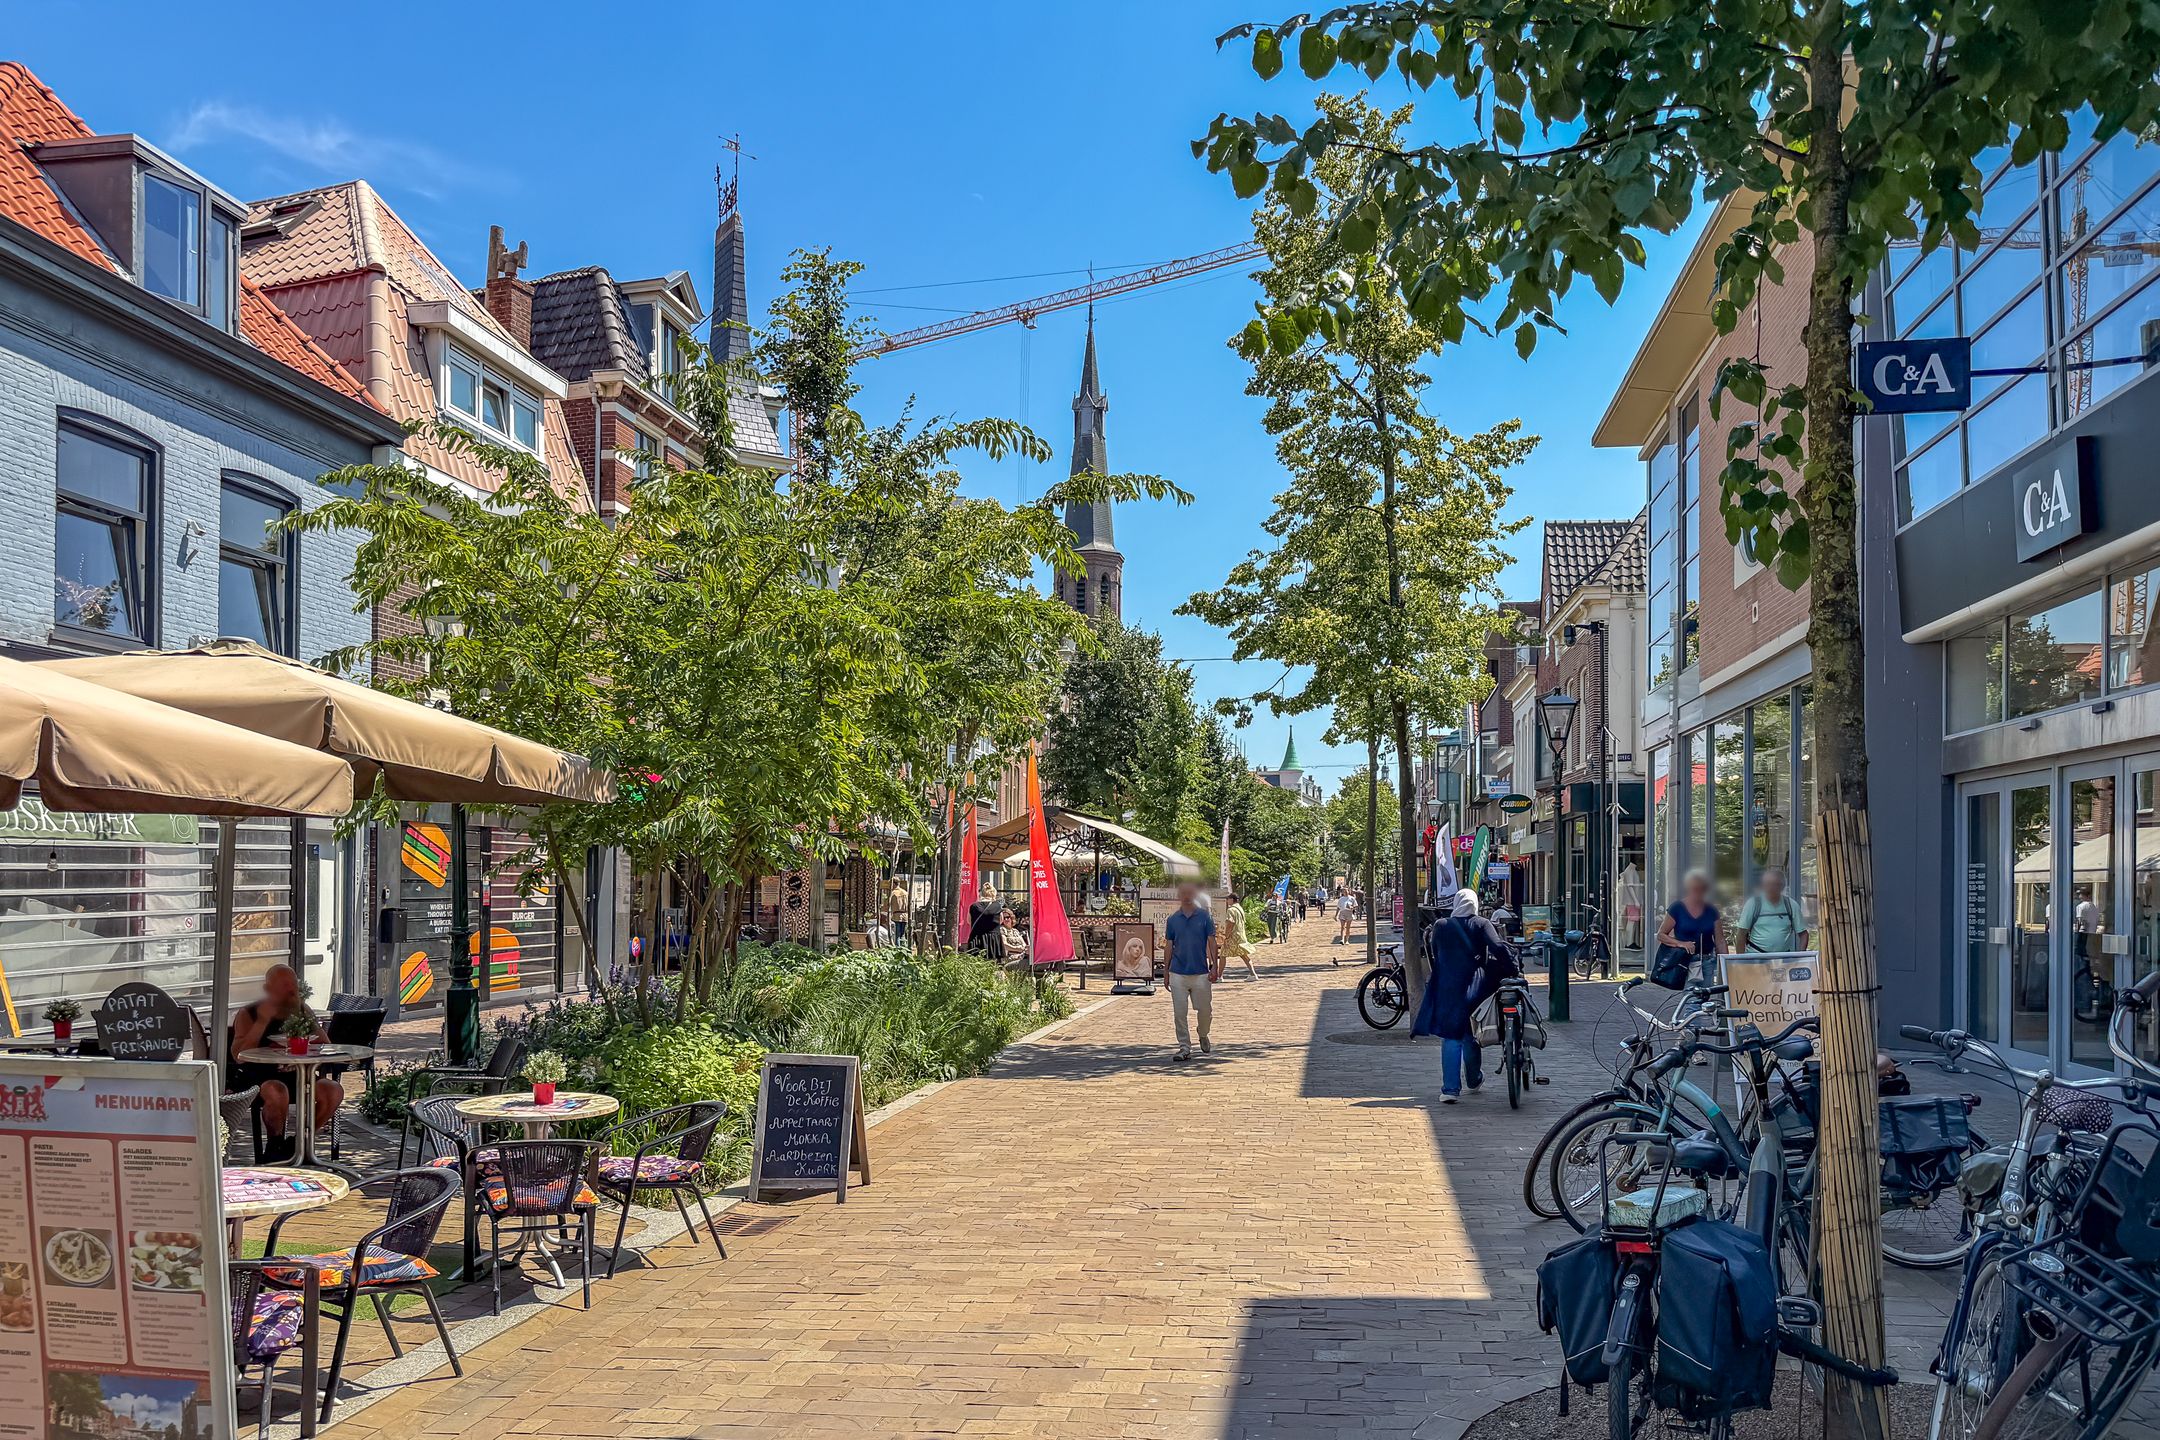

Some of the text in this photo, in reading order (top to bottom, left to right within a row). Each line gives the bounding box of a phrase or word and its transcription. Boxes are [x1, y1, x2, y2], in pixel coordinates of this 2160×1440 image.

[1873, 353, 1955, 395] C&A
[2023, 469, 2072, 537] C&A
[1501, 800, 1531, 808] SUBWAY
[512, 912, 535, 920] BURGER
[108, 993, 158, 1012] PATAT
[1735, 989, 1808, 1006] Word nu
[112, 1038, 182, 1054] FRIKANDEL
[96, 1094, 194, 1111] MENUKAAR
[786, 1092, 839, 1106] De Koffie
[784, 1133, 831, 1146] MOKKA
